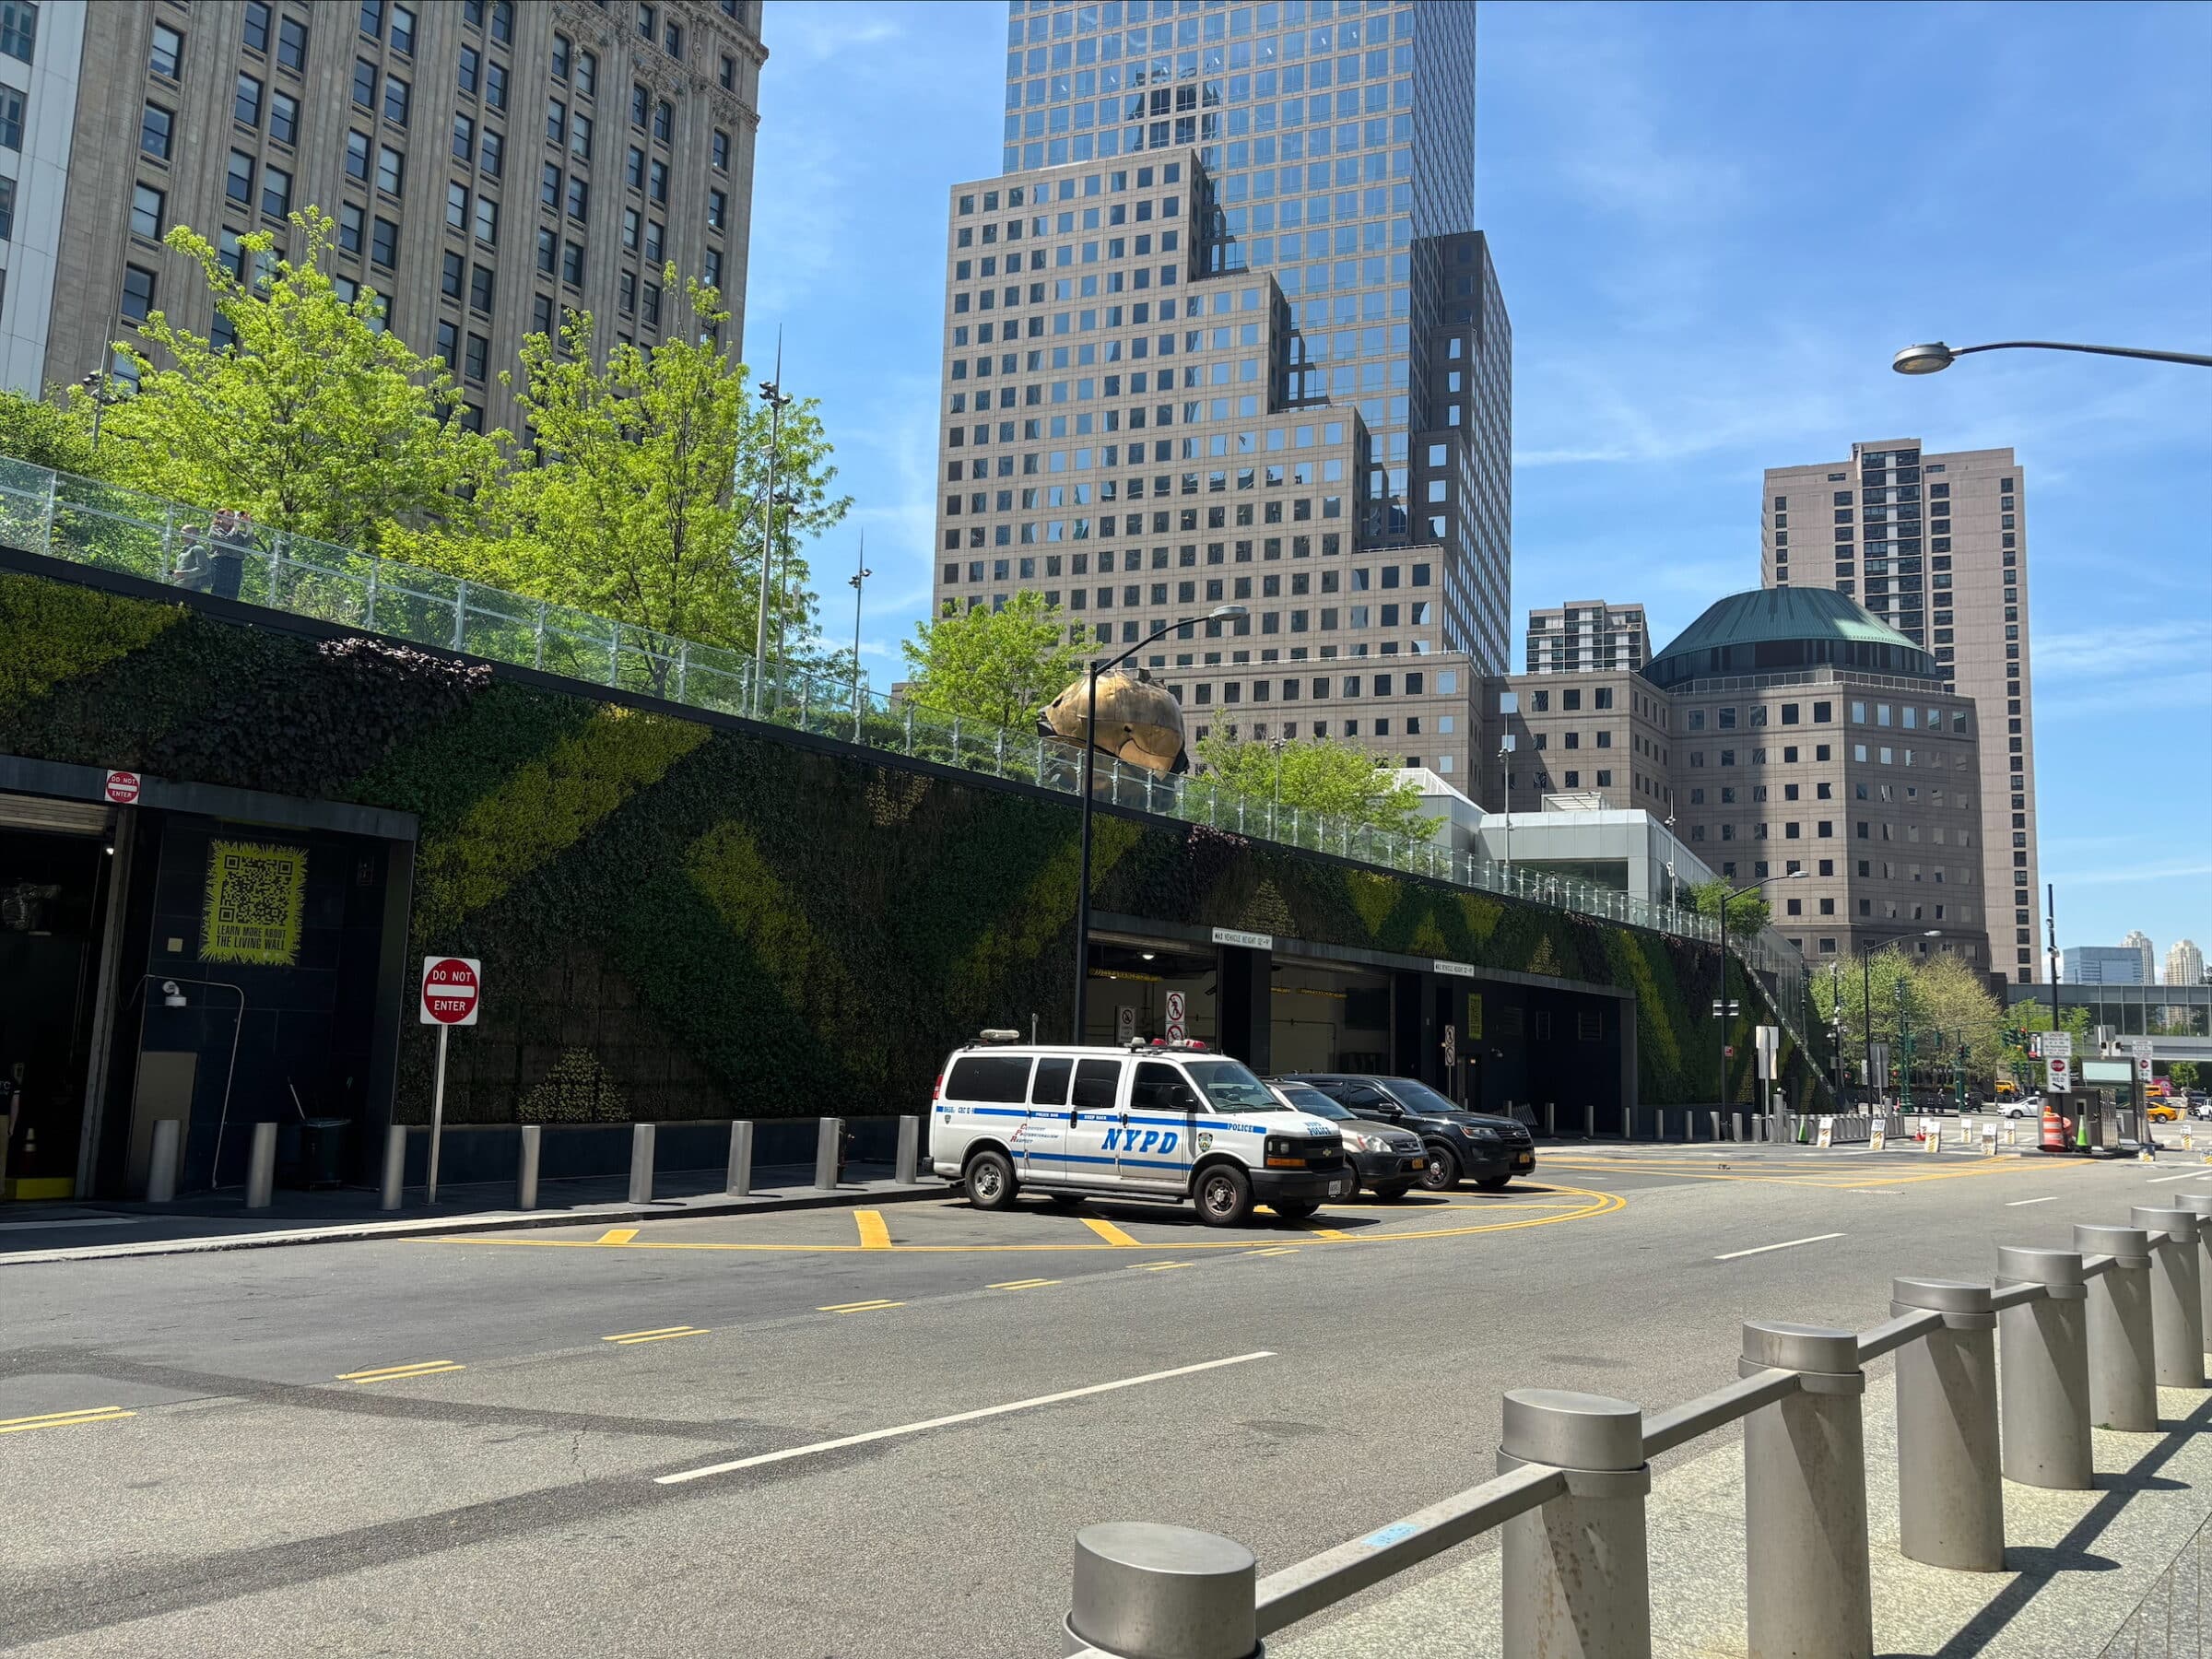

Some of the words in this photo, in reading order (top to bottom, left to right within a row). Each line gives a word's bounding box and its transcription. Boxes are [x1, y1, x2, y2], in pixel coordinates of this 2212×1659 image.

[218, 924, 241, 936] LEARN
[242, 926, 262, 938] MORE
[265, 928, 287, 939] ABOUT
[217, 935, 232, 947] THE
[234, 936, 262, 949] LIVING
[265, 939, 286, 951] WALL
[1224, 933, 1241, 943] VEHICLE
[432, 970, 447, 982] DO
[452, 971, 473, 982] NOT
[434, 1000, 466, 1011] ENTER
[1228, 1123, 1253, 1133] POLICE
[1307, 1126, 1332, 1135] POLICE
[1101, 1127, 1179, 1154] NYPD
